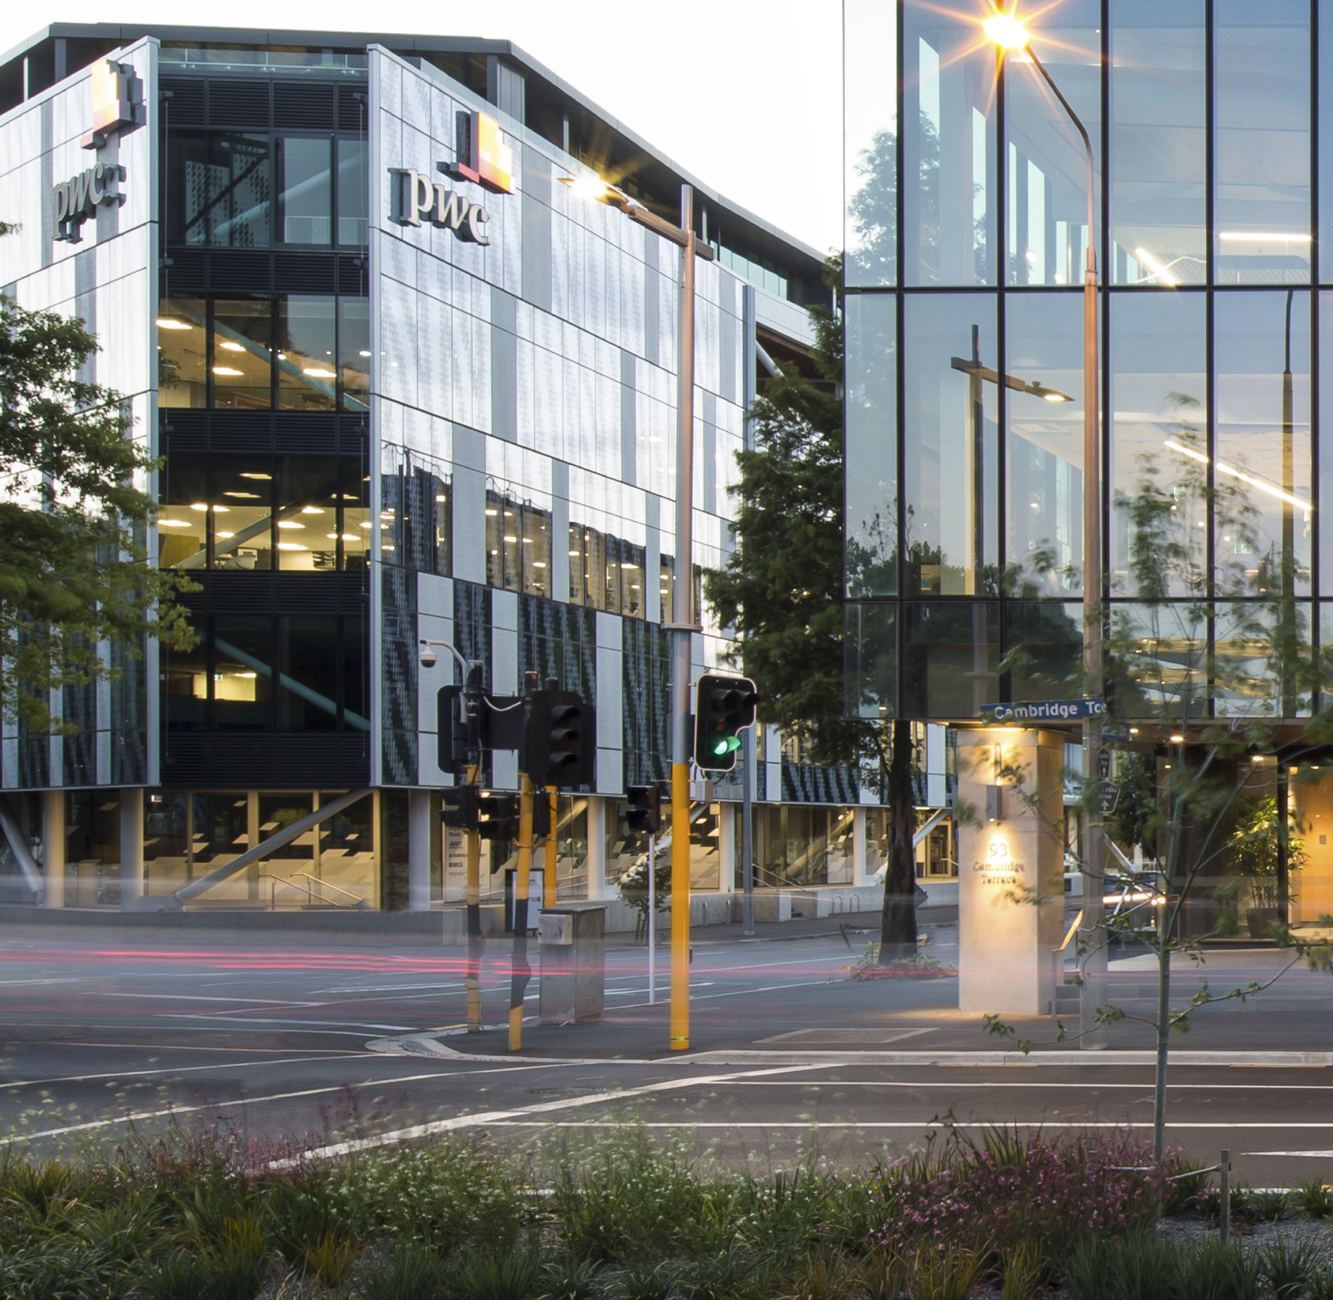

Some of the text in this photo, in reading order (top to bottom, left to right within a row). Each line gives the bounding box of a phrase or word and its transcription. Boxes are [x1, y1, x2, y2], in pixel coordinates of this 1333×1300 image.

[52, 161, 104, 241] pwc
[403, 167, 490, 245] pwc
[993, 701, 1107, 720] Cambridge Tce
[989, 842, 1008, 858] 93
[973, 861, 1025, 873] Cambridge
[981, 874, 1017, 884] Terrace
